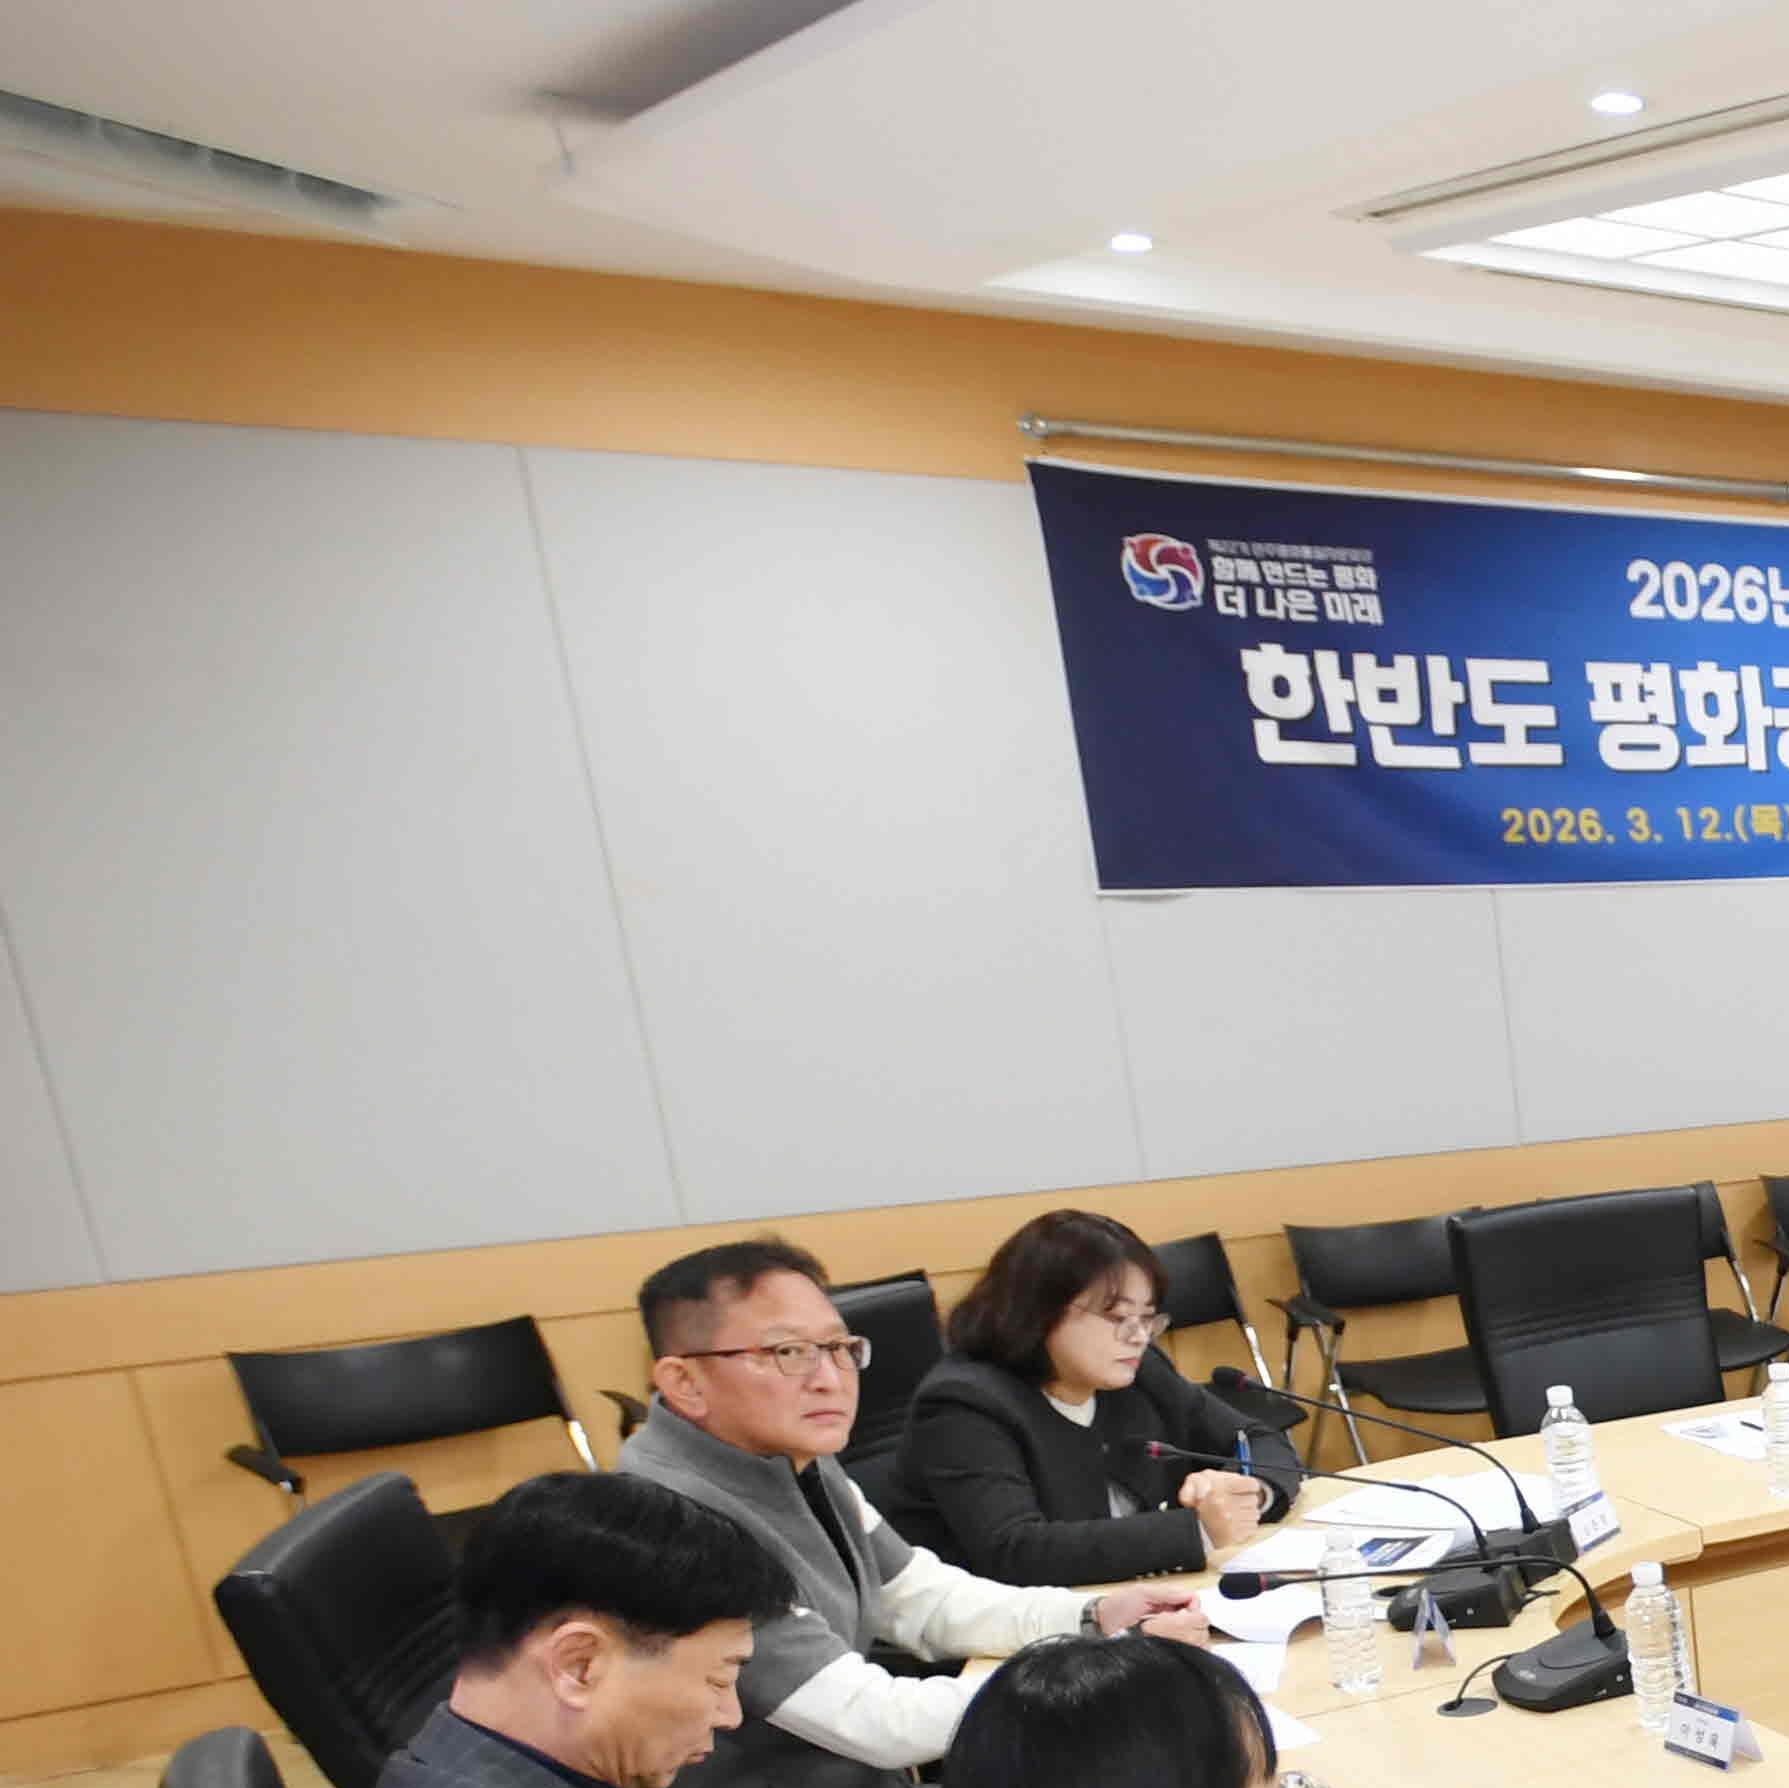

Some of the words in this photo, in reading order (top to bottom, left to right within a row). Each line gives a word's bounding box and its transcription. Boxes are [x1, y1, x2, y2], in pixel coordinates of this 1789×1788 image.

[1214, 585, 1247, 618] 더
[1255, 587, 1318, 622] 나은
[1322, 591, 1384, 626] 미래
[1240, 643, 1564, 769] 한반도
[1501, 806, 1616, 845] 2026.
[1625, 806, 1663, 843] 3.
